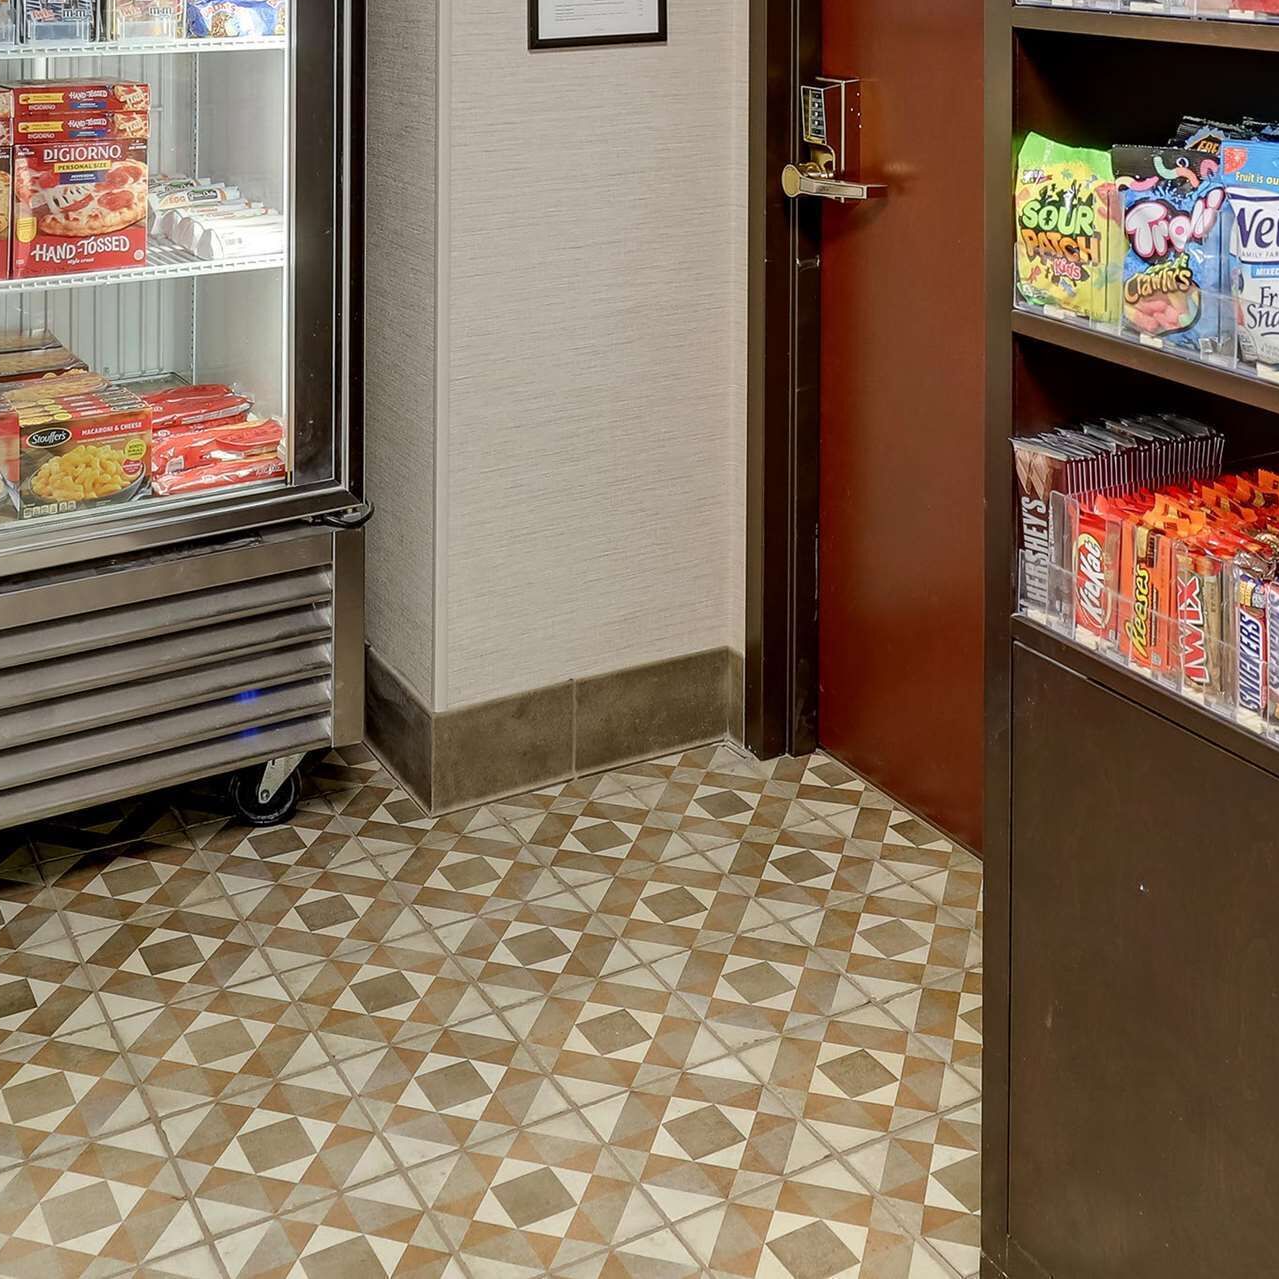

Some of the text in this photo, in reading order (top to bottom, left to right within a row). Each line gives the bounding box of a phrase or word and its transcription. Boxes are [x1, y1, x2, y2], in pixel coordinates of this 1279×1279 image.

[58, 163, 93, 171] PERSONAL
[1235, 171, 1254, 184] Fruit
[1256, 175, 1264, 184] is
[1021, 203, 1095, 237] SOUR
[31, 235, 130, 263] HAND-TOSSED
[1021, 229, 1101, 265] PATCH
[32, 431, 68, 445] Stouffer's
[81, 425, 114, 435] MACARONI
[120, 421, 142, 430] CHEESE
[1021, 496, 1051, 610] HERSHEY'S
[1176, 574, 1209, 684] TWIX
[1238, 609, 1262, 710] SNICKERS
